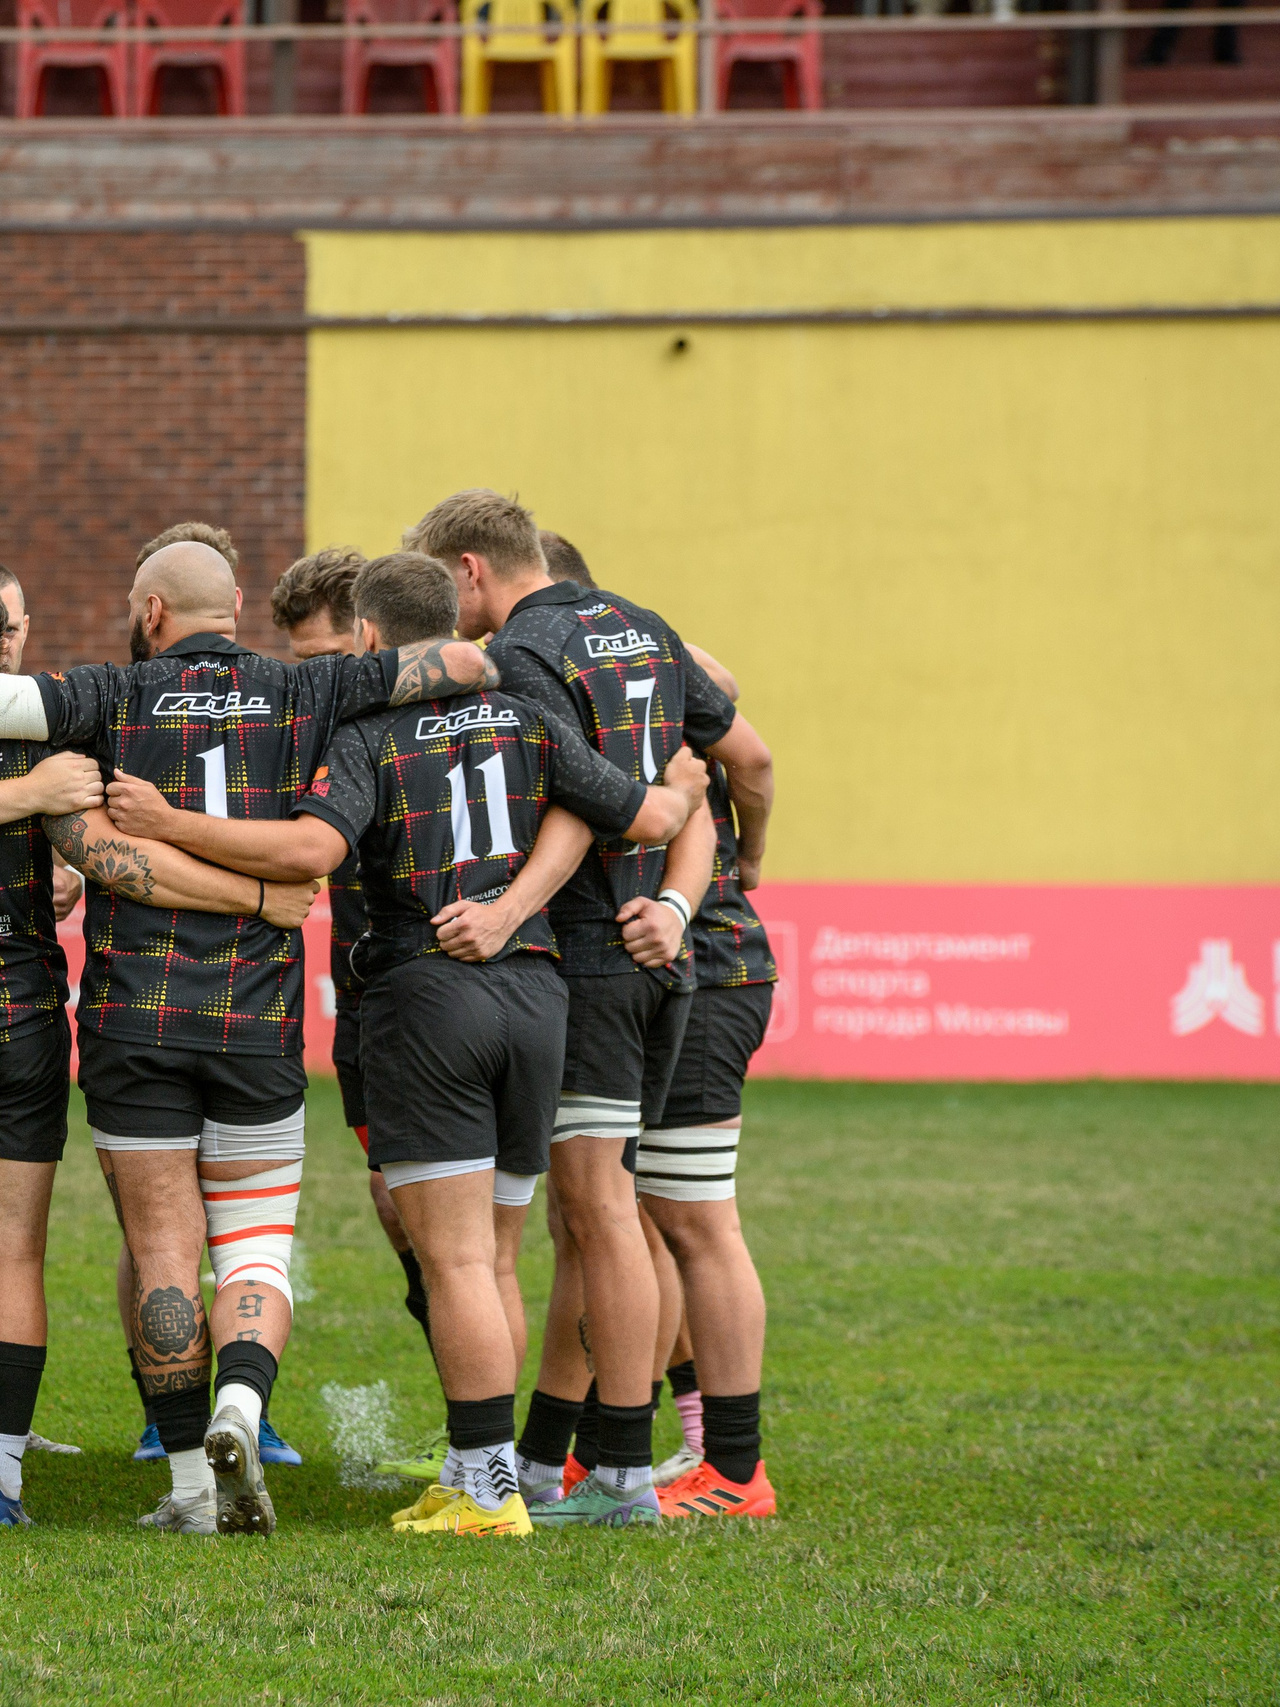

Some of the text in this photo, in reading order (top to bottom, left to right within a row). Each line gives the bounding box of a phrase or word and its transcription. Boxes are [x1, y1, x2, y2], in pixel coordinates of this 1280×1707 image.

[195, 744, 228, 819] 1
[626, 677, 658, 784] 7
[445, 752, 519, 865] 11
